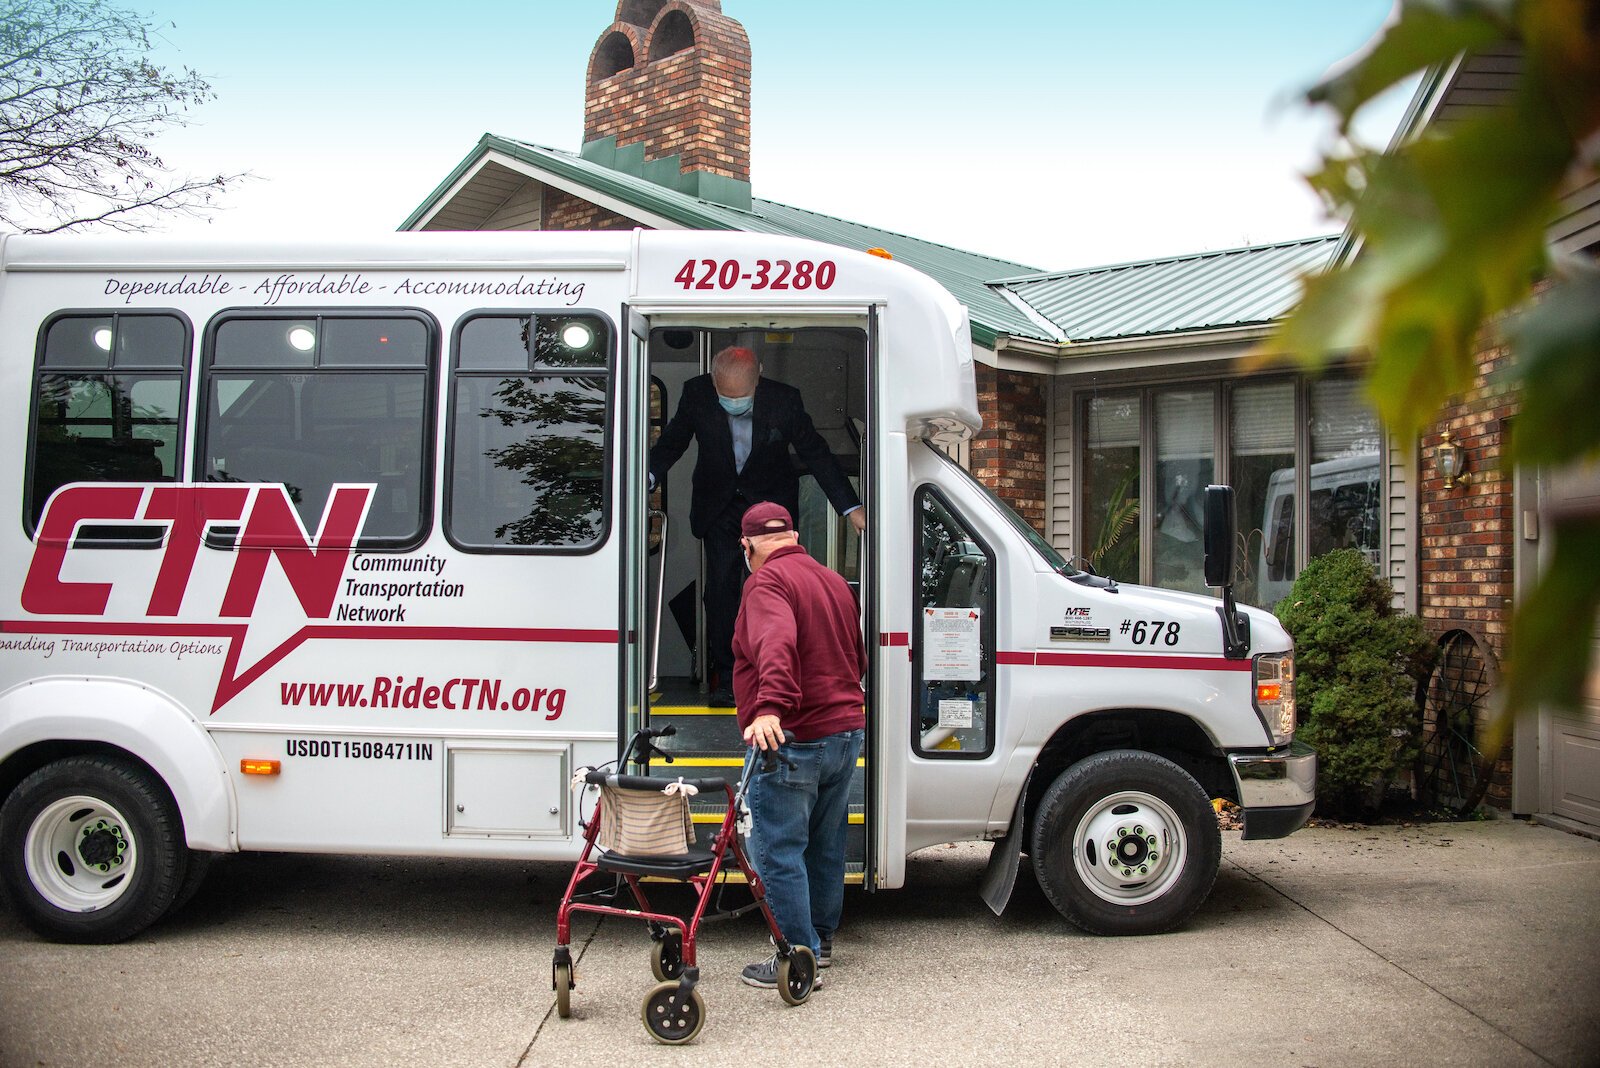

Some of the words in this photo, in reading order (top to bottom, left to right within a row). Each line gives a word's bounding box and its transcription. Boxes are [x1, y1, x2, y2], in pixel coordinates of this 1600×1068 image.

[674, 259, 836, 290] 420-3280
[104, 275, 232, 304] Dependable
[253, 274, 370, 305] Affordable
[394, 275, 586, 305] Accommodating
[20, 484, 376, 619] CTN
[352, 554, 446, 576] Community
[345, 579, 464, 599] Transportation
[337, 604, 406, 623] Network
[1119, 619, 1181, 647] #678
[61, 639, 167, 659] Transportation
[170, 641, 223, 660] Options
[280, 676, 567, 721] www.RideCTN.org
[286, 739, 433, 761] USDOT1508471IN
